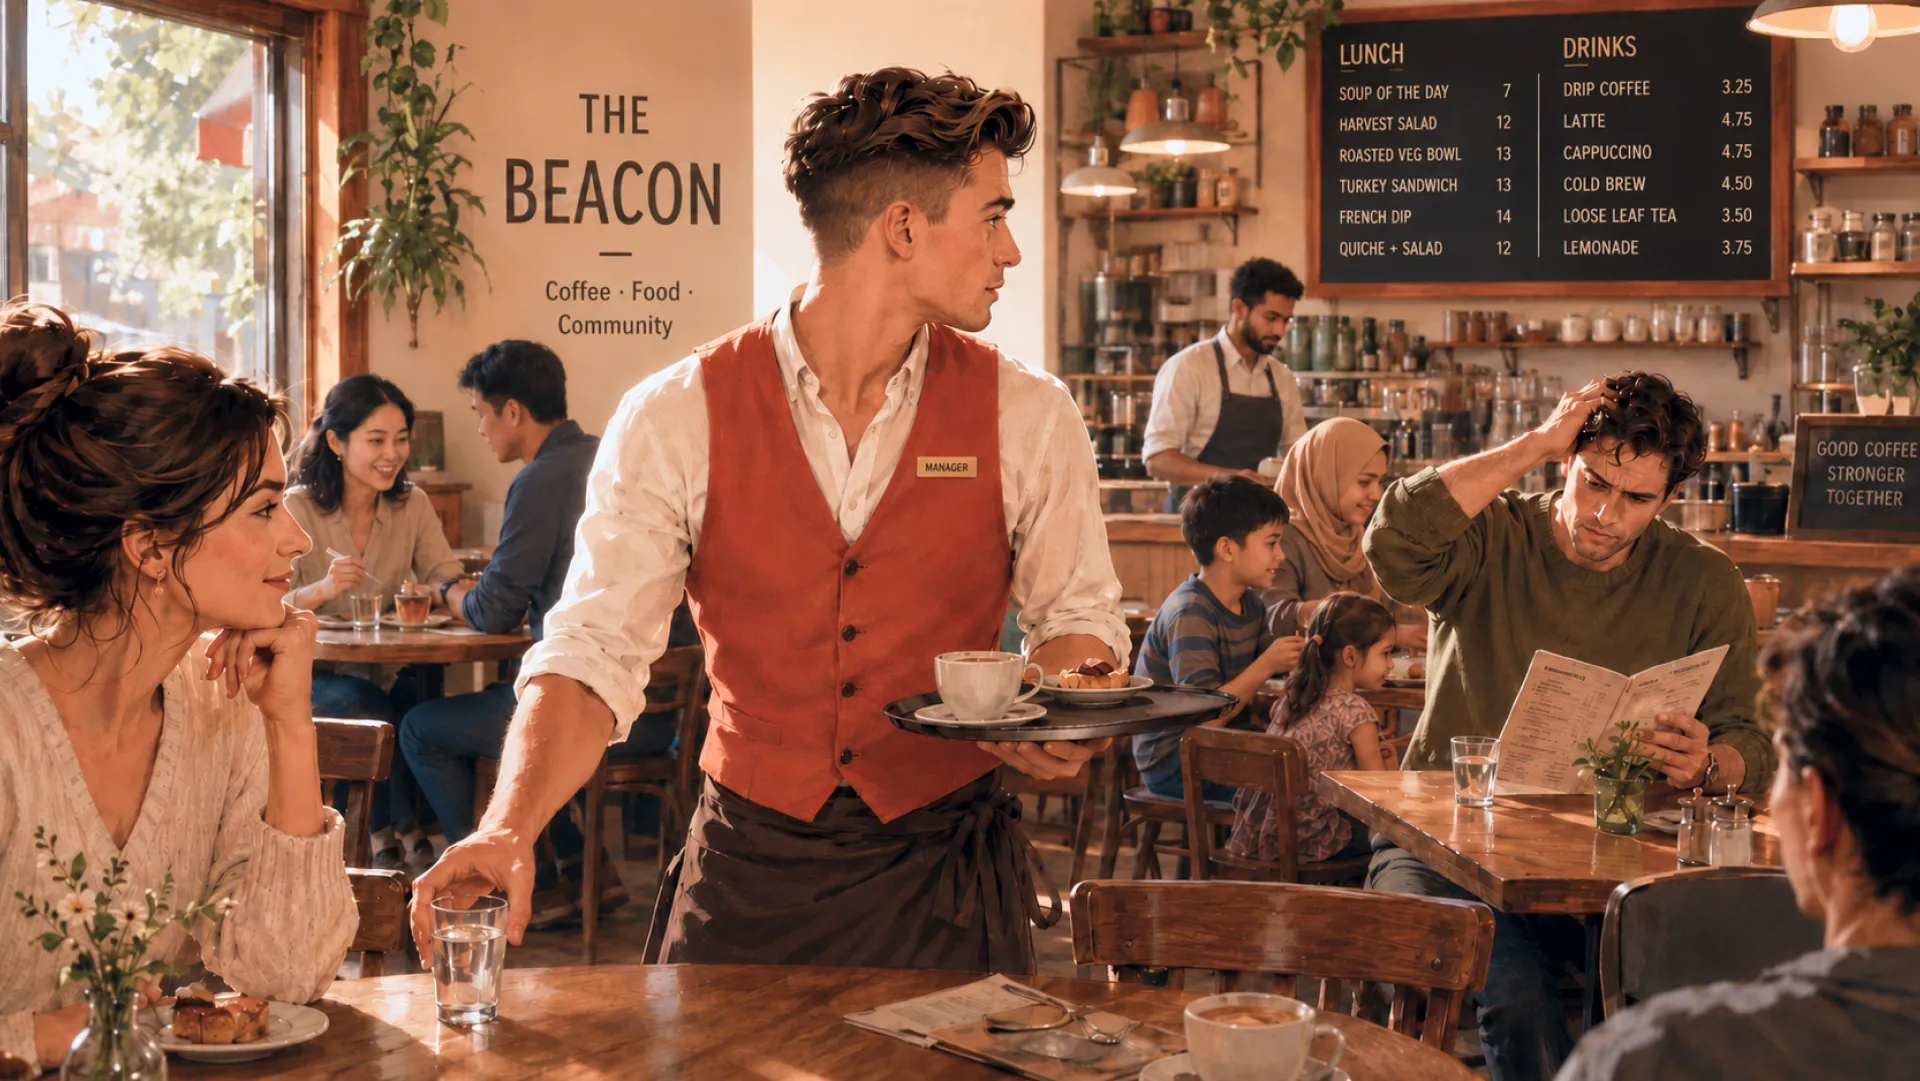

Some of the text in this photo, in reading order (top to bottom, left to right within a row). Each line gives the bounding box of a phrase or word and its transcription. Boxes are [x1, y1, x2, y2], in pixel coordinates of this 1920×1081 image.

[1340, 42, 1404, 66] LUNCH
[1563, 34, 1637, 59] DRINKS
[1339, 83, 1512, 101] SOUP OF THE DAY 7
[1563, 78, 1753, 97] DRIP COFFEE 3.25
[578, 93, 650, 135] THE
[1339, 114, 1511, 132] HARVEST SALAD 12
[1563, 111, 1753, 129] LATTE 4.75
[1339, 145, 1512, 163] ROASTED VEG BOWL 13
[1563, 143, 1753, 161] CAPPUCCINO 4.75
[505, 157, 721, 226] BEACON
[1339, 177, 1512, 194] TURKEY SANDWICH 13
[1563, 175, 1753, 192] COLD BREW 4.50
[1339, 208, 1512, 225] FRENCH DIP 14
[1563, 207, 1753, 224] LOOSE LEAF TEA 3.50
[1339, 240, 1385, 258] QUICHE
[1402, 240, 1443, 256] SALAD
[1496, 240, 1511, 256] 12
[1563, 239, 1753, 256] LEMONADE 3.75
[545, 279, 611, 302] Coffee
[632, 280, 680, 302] Food
[558, 313, 674, 340] Community
[1816, 440, 1918, 458] GOOD COFFEE
[925, 462, 969, 473] MANAGER
[1827, 465, 1905, 483] STRONGER
[1826, 488, 1904, 506] TOGETHER
